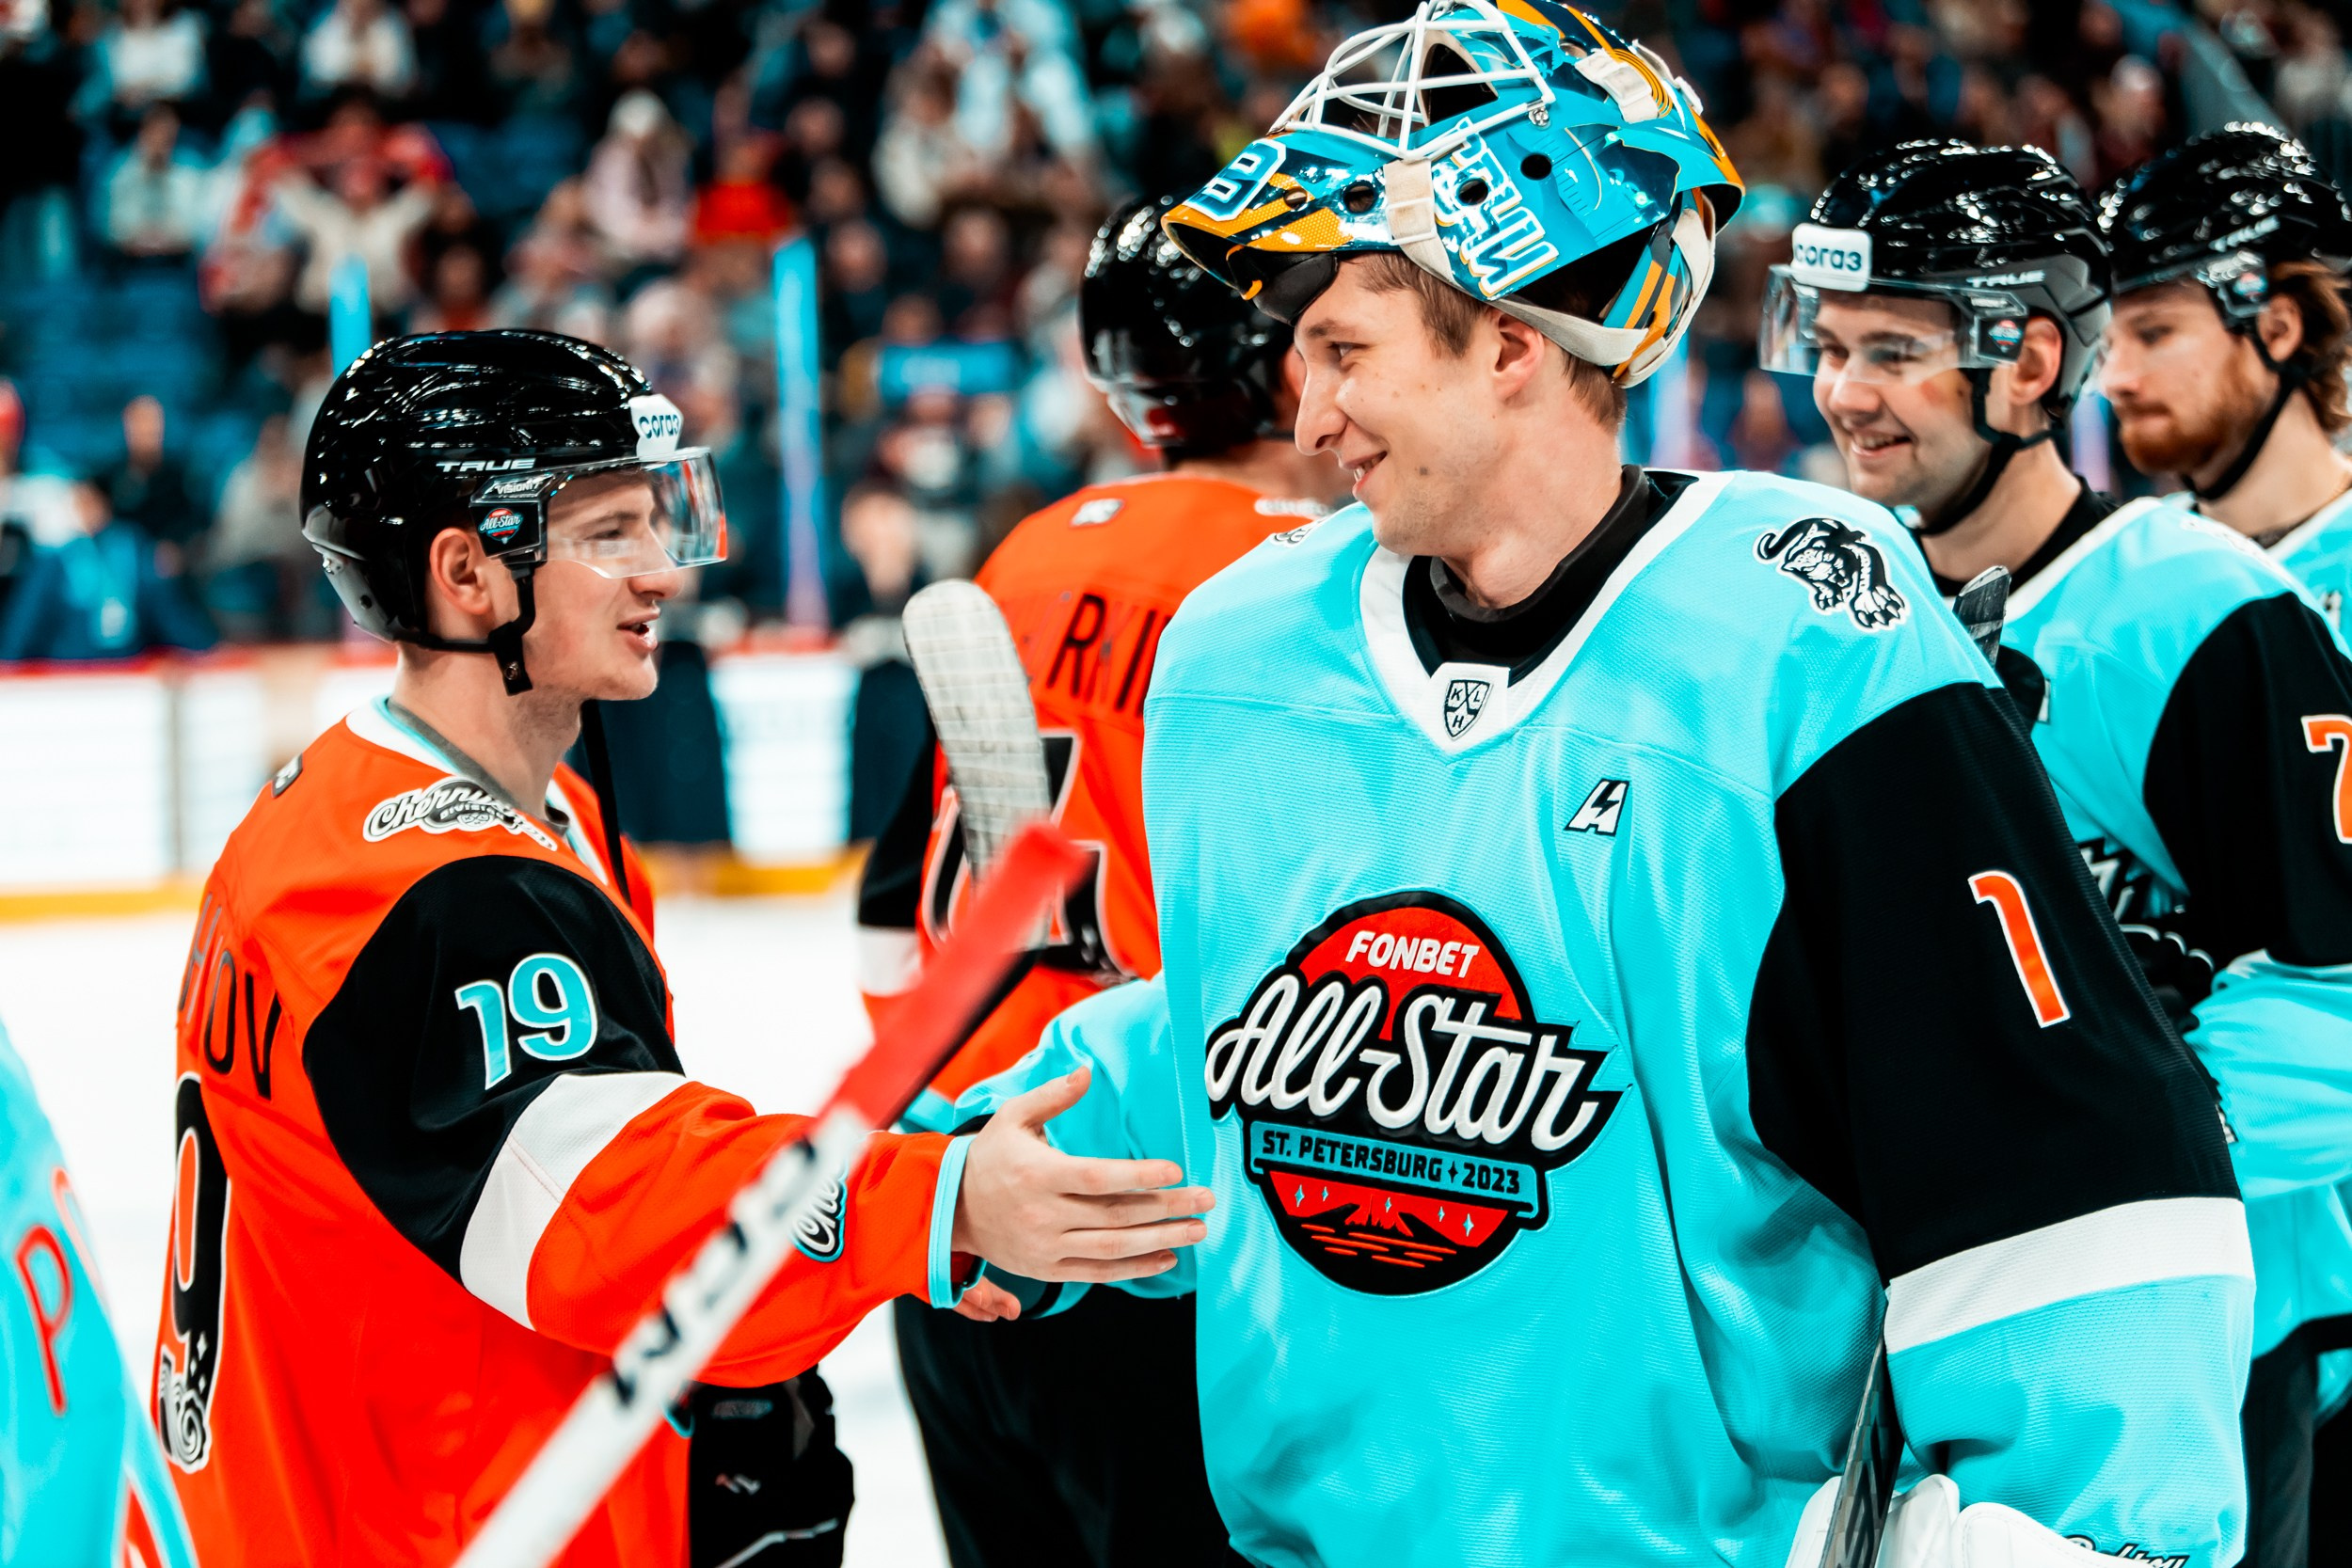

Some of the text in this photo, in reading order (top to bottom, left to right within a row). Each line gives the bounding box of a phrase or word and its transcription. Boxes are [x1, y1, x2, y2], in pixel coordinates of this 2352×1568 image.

[436, 458, 536, 472] TRUE
[1344, 930, 1480, 978] FONBET
[1967, 870, 2071, 1028] 1
[453, 952, 598, 1091] 19
[1204, 974, 1599, 1152] All-Star
[1262, 1130, 1521, 1195] ST. PETERSBURG 2023
